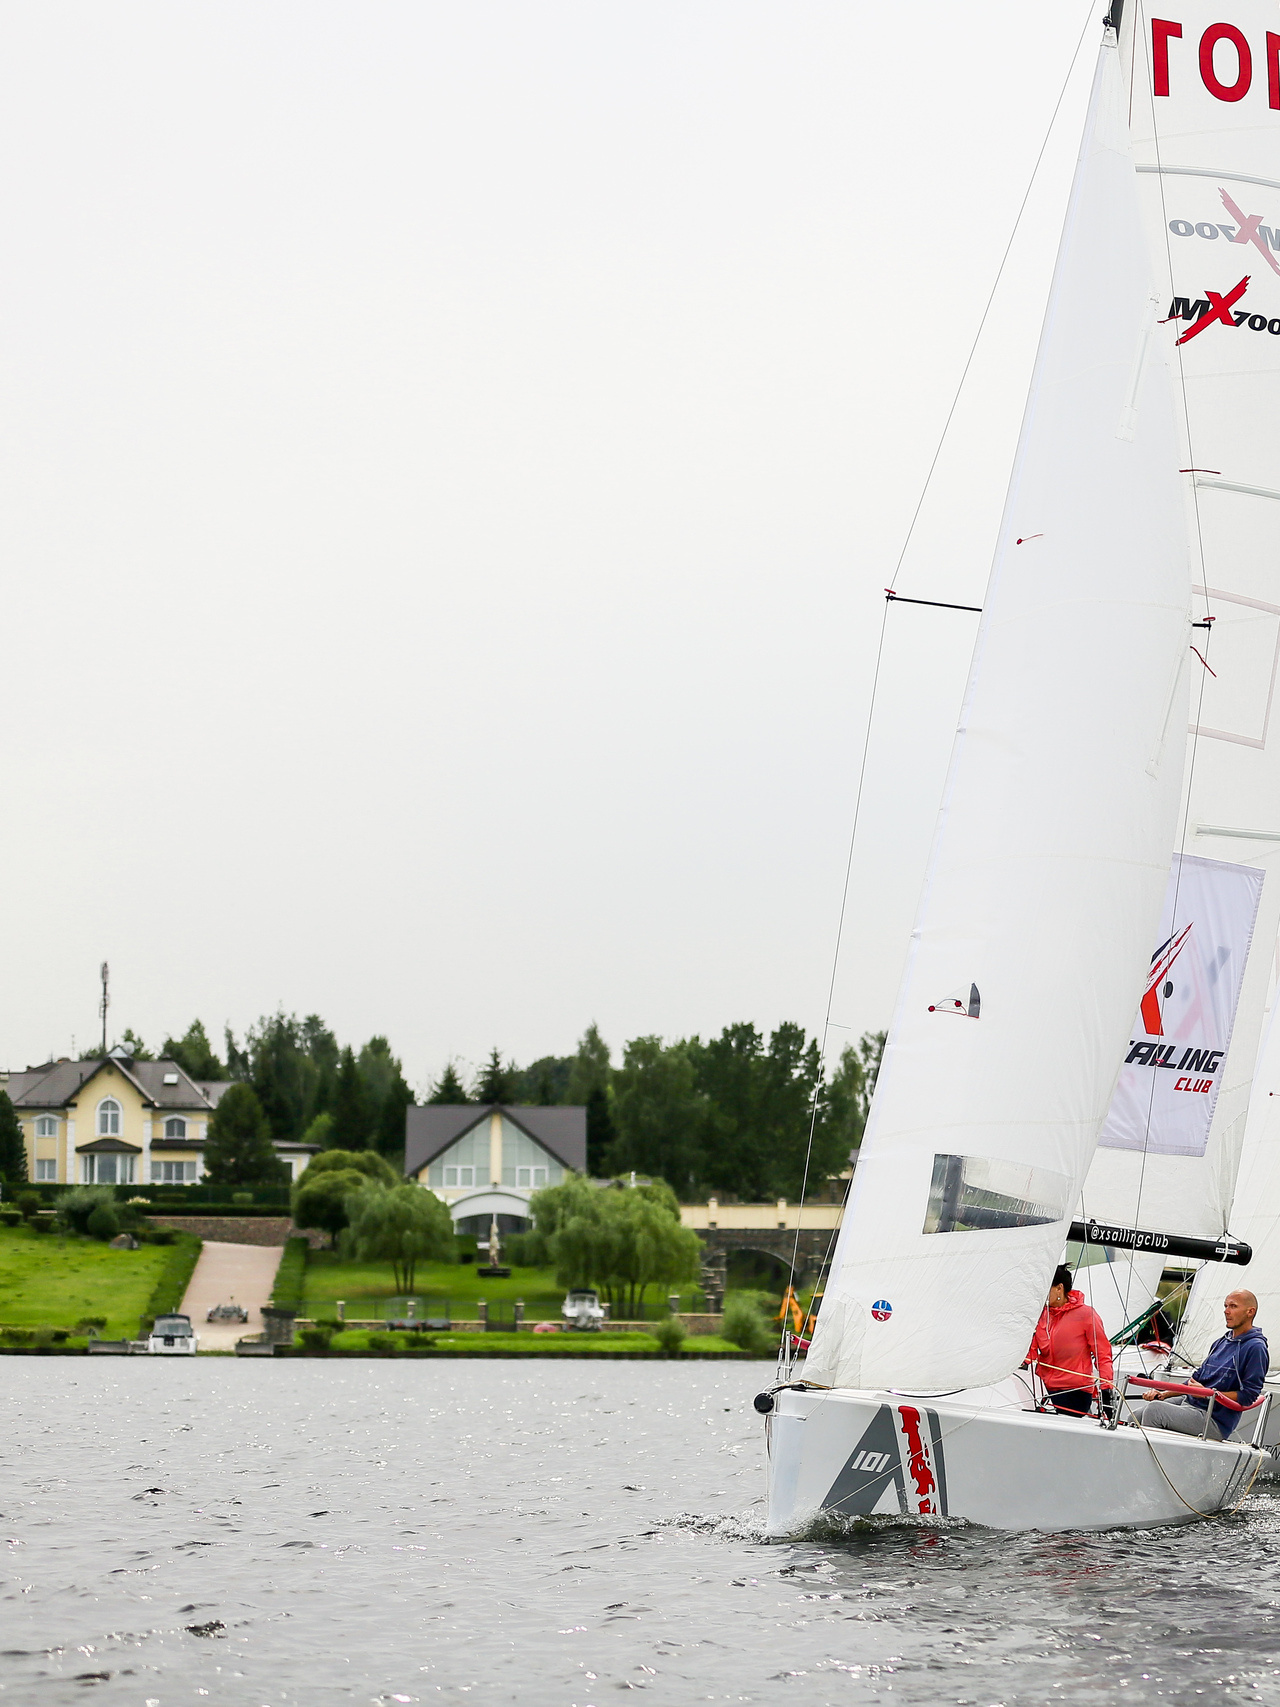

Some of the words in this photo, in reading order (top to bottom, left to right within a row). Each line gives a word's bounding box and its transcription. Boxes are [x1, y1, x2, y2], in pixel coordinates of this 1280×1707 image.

[1124, 1039, 1226, 1073] AILING
[1174, 1077, 1213, 1093] CLUB
[1090, 1225, 1169, 1248] @xsailingclub
[851, 1450, 892, 1473] 101
